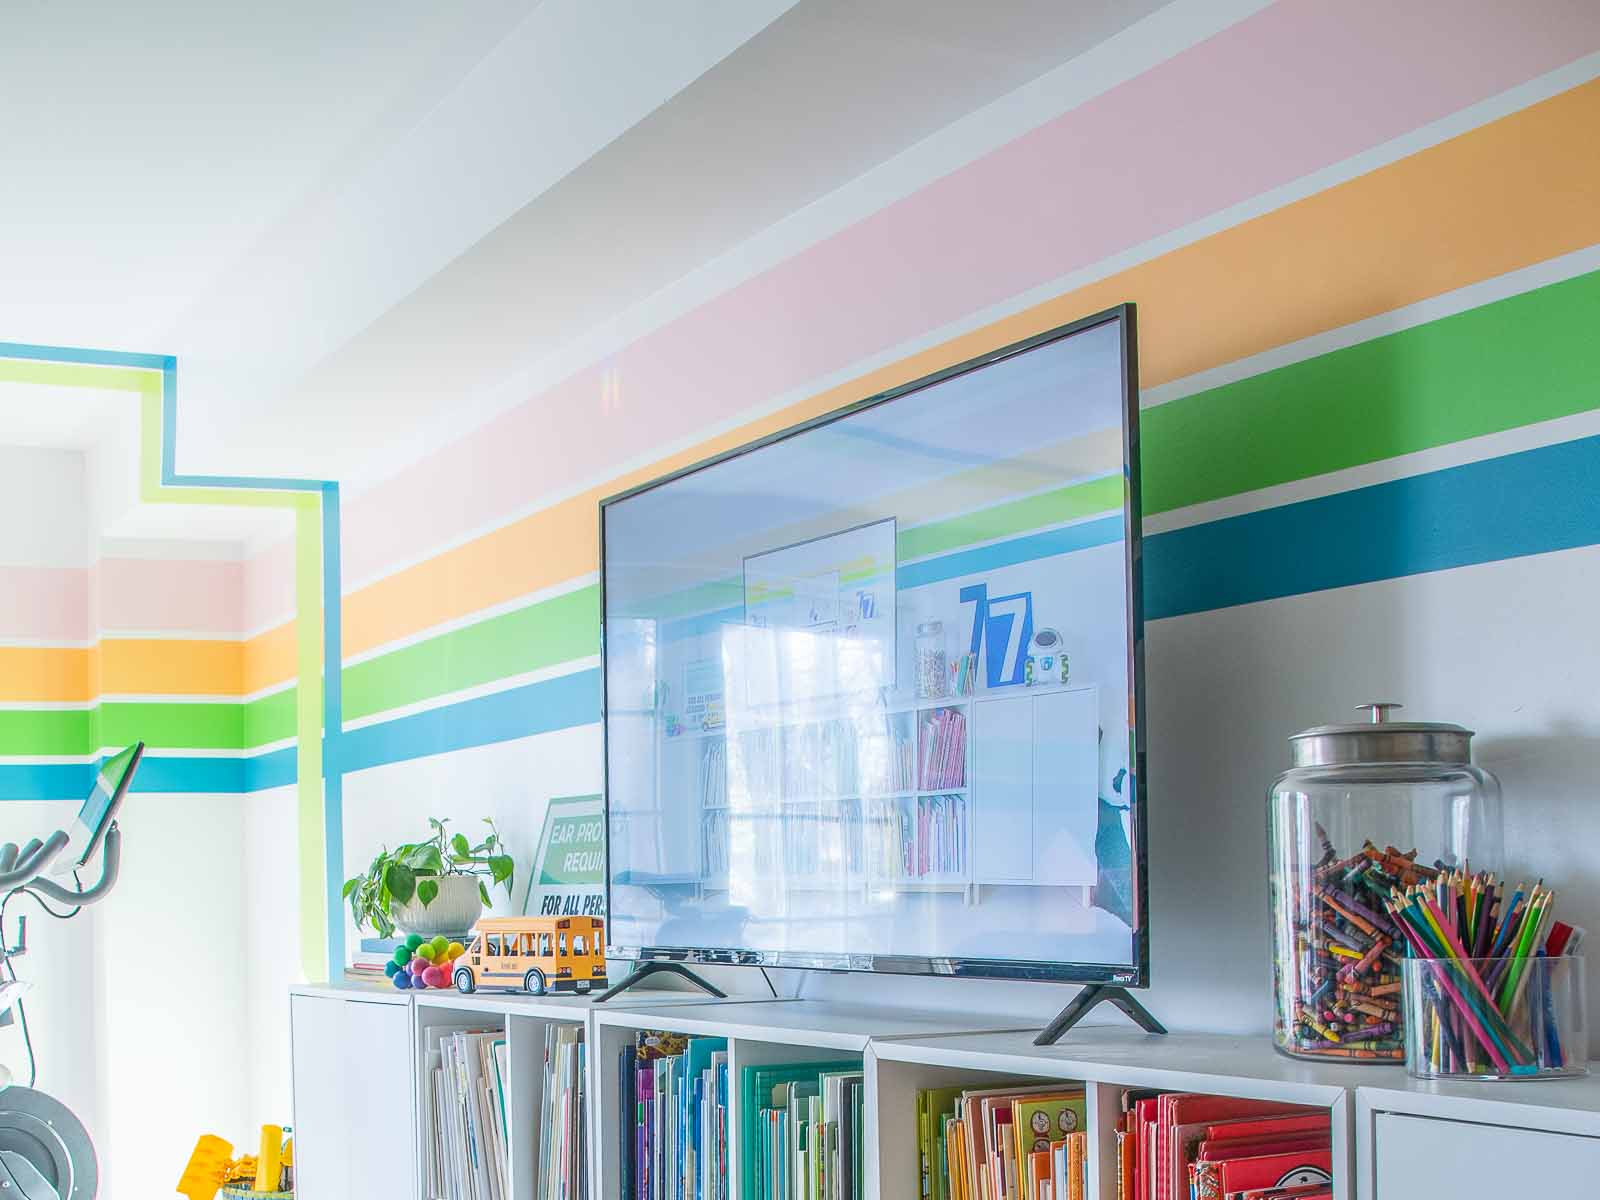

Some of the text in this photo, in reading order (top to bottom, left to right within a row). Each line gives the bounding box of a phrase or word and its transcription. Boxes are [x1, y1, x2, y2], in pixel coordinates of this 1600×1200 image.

[960, 583, 1031, 687] 77
[551, 822, 604, 843] EAR PRO
[541, 895, 562, 916] FOR
[562, 895, 581, 916] ALL
